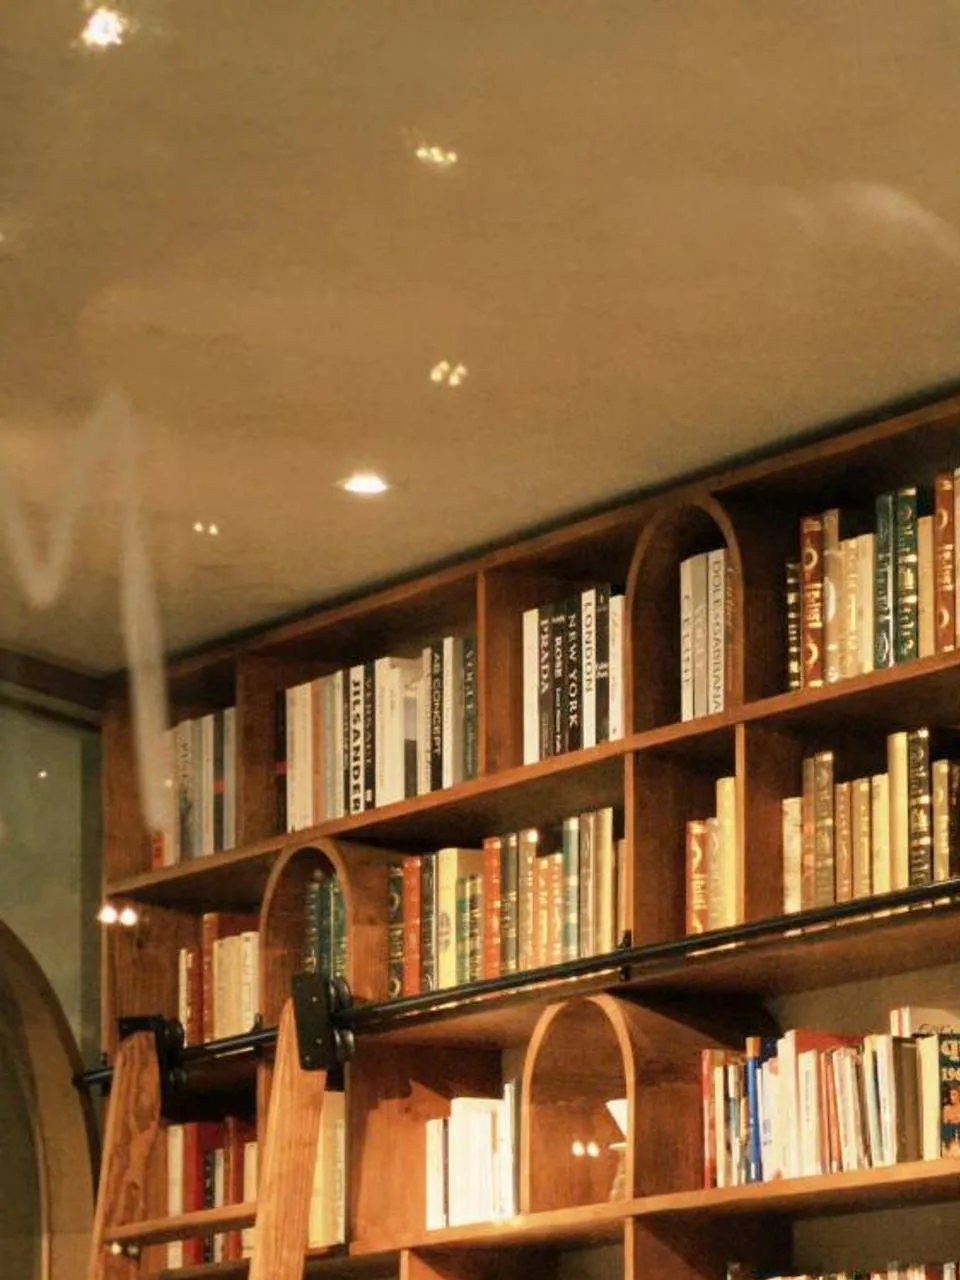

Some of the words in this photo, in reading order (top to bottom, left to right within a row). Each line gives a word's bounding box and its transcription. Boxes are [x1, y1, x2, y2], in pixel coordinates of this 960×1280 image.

[540, 618, 549, 694] PRADA
[568, 613, 577, 660] NEW
[433, 678, 442, 756] CONCEPT
[568, 669, 578, 729] YORK
